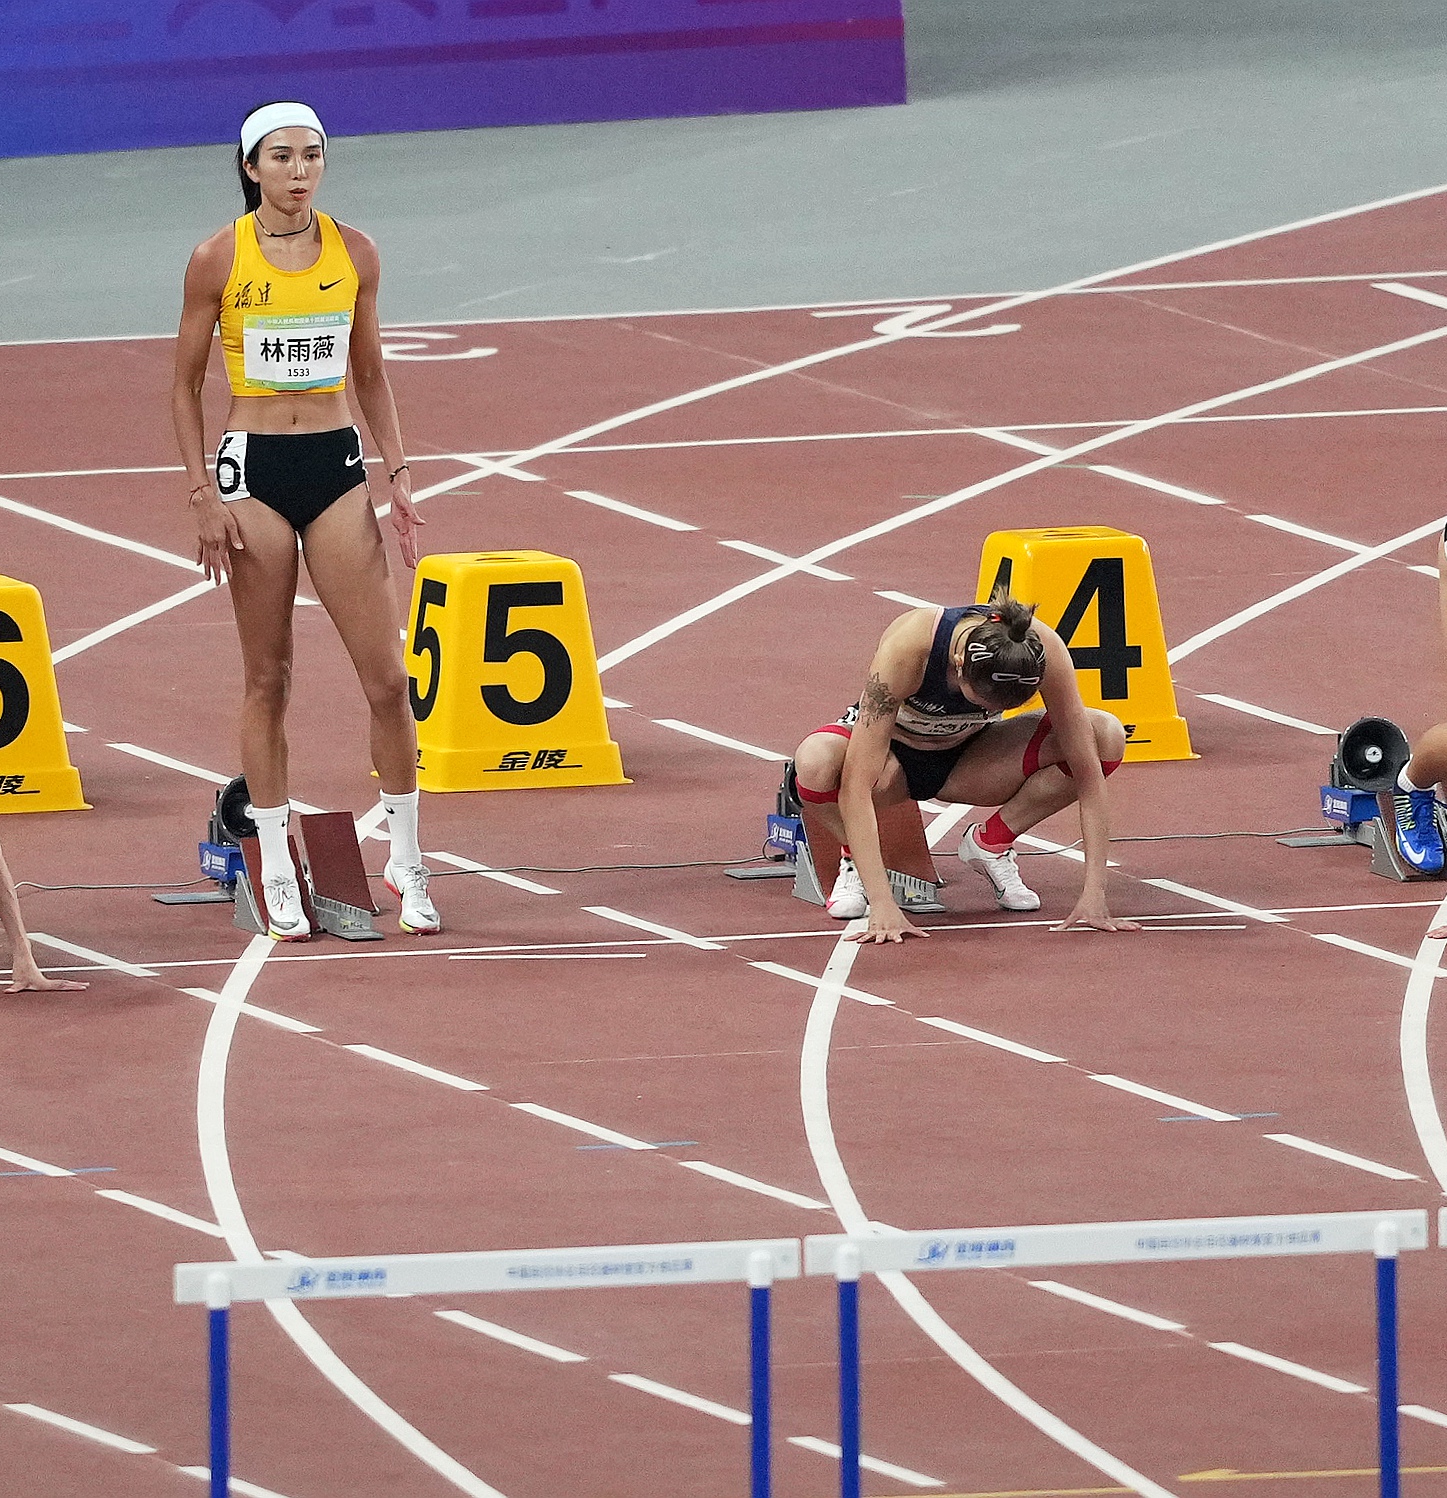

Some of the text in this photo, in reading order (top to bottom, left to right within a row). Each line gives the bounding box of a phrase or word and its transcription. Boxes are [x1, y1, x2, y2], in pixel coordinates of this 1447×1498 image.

[235, 281, 273, 309] 福建
[260, 335, 335, 362] 林雨薇
[288, 368, 310, 377] 1533
[217, 437, 241, 494] 6
[409, 578, 447, 721] 5
[1054, 557, 1141, 700] 4
[480, 581, 573, 726] 5
[483, 749, 582, 772] 金陵
